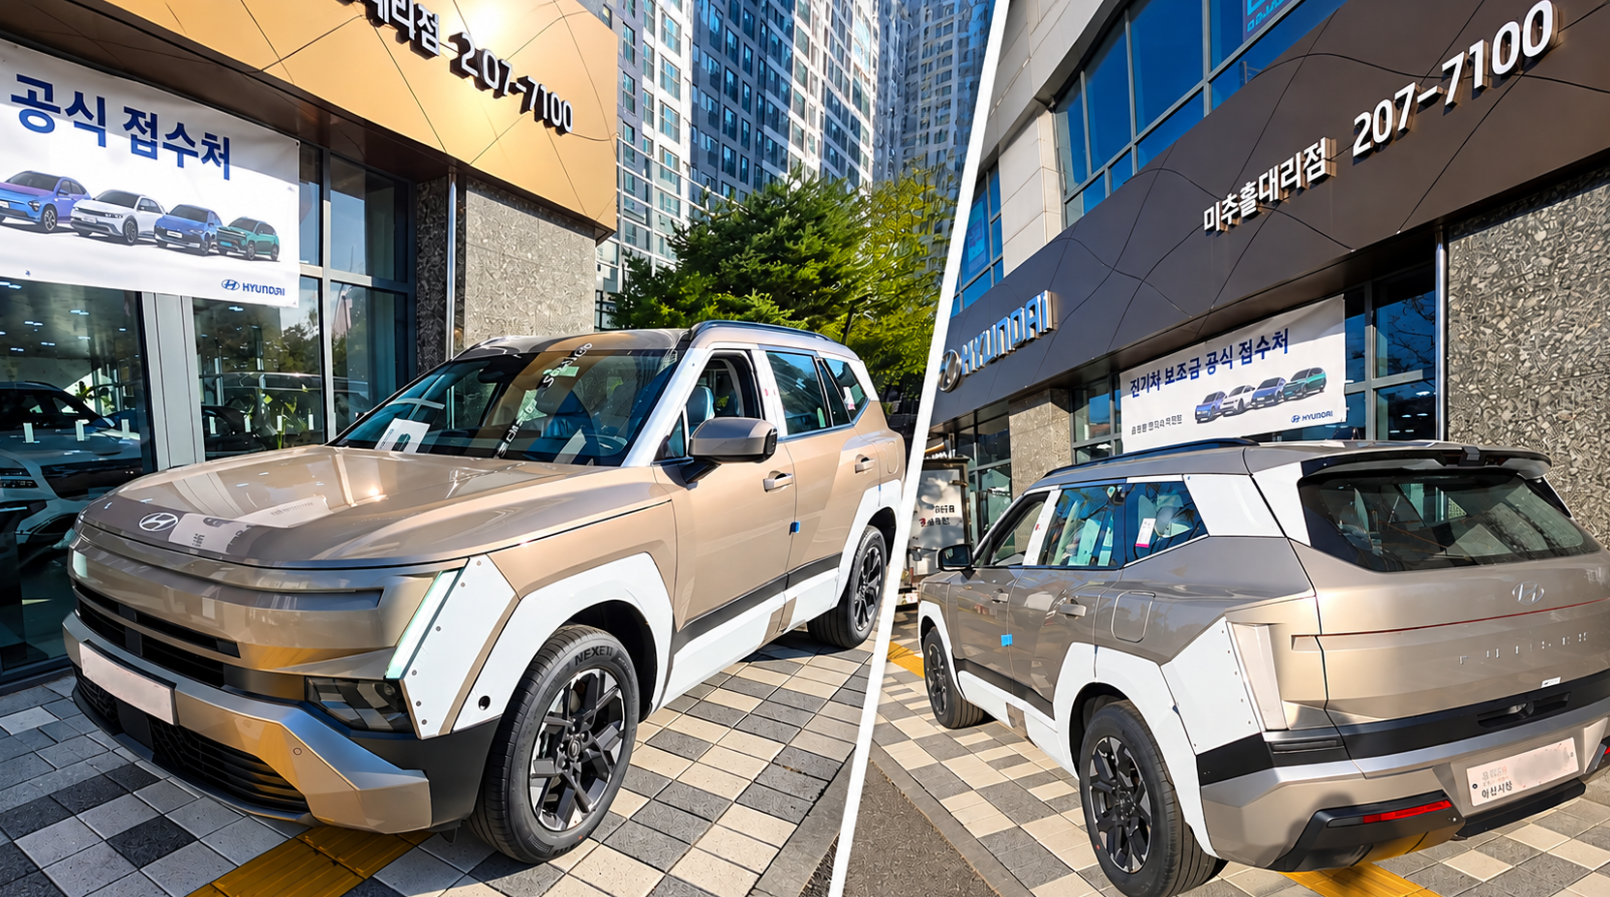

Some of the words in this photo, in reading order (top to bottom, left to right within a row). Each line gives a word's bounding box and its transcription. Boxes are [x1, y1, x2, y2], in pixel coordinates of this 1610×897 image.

[11, 73, 107, 148] 공식
[123, 105, 230, 181] 접수처
[450, 32, 573, 134] 207-7100
[1204, 136, 1327, 232] 미추홀대리점
[1353, 0, 1554, 158] 207-7100
[242, 282, 286, 296] HYUNDAI
[961, 289, 1056, 377] HYUNDAI
[1164, 356, 1202, 385] 보조금
[1205, 344, 1233, 375] 공식
[1238, 327, 1288, 366] 접수처
[1301, 410, 1334, 422] HYUNDAI
